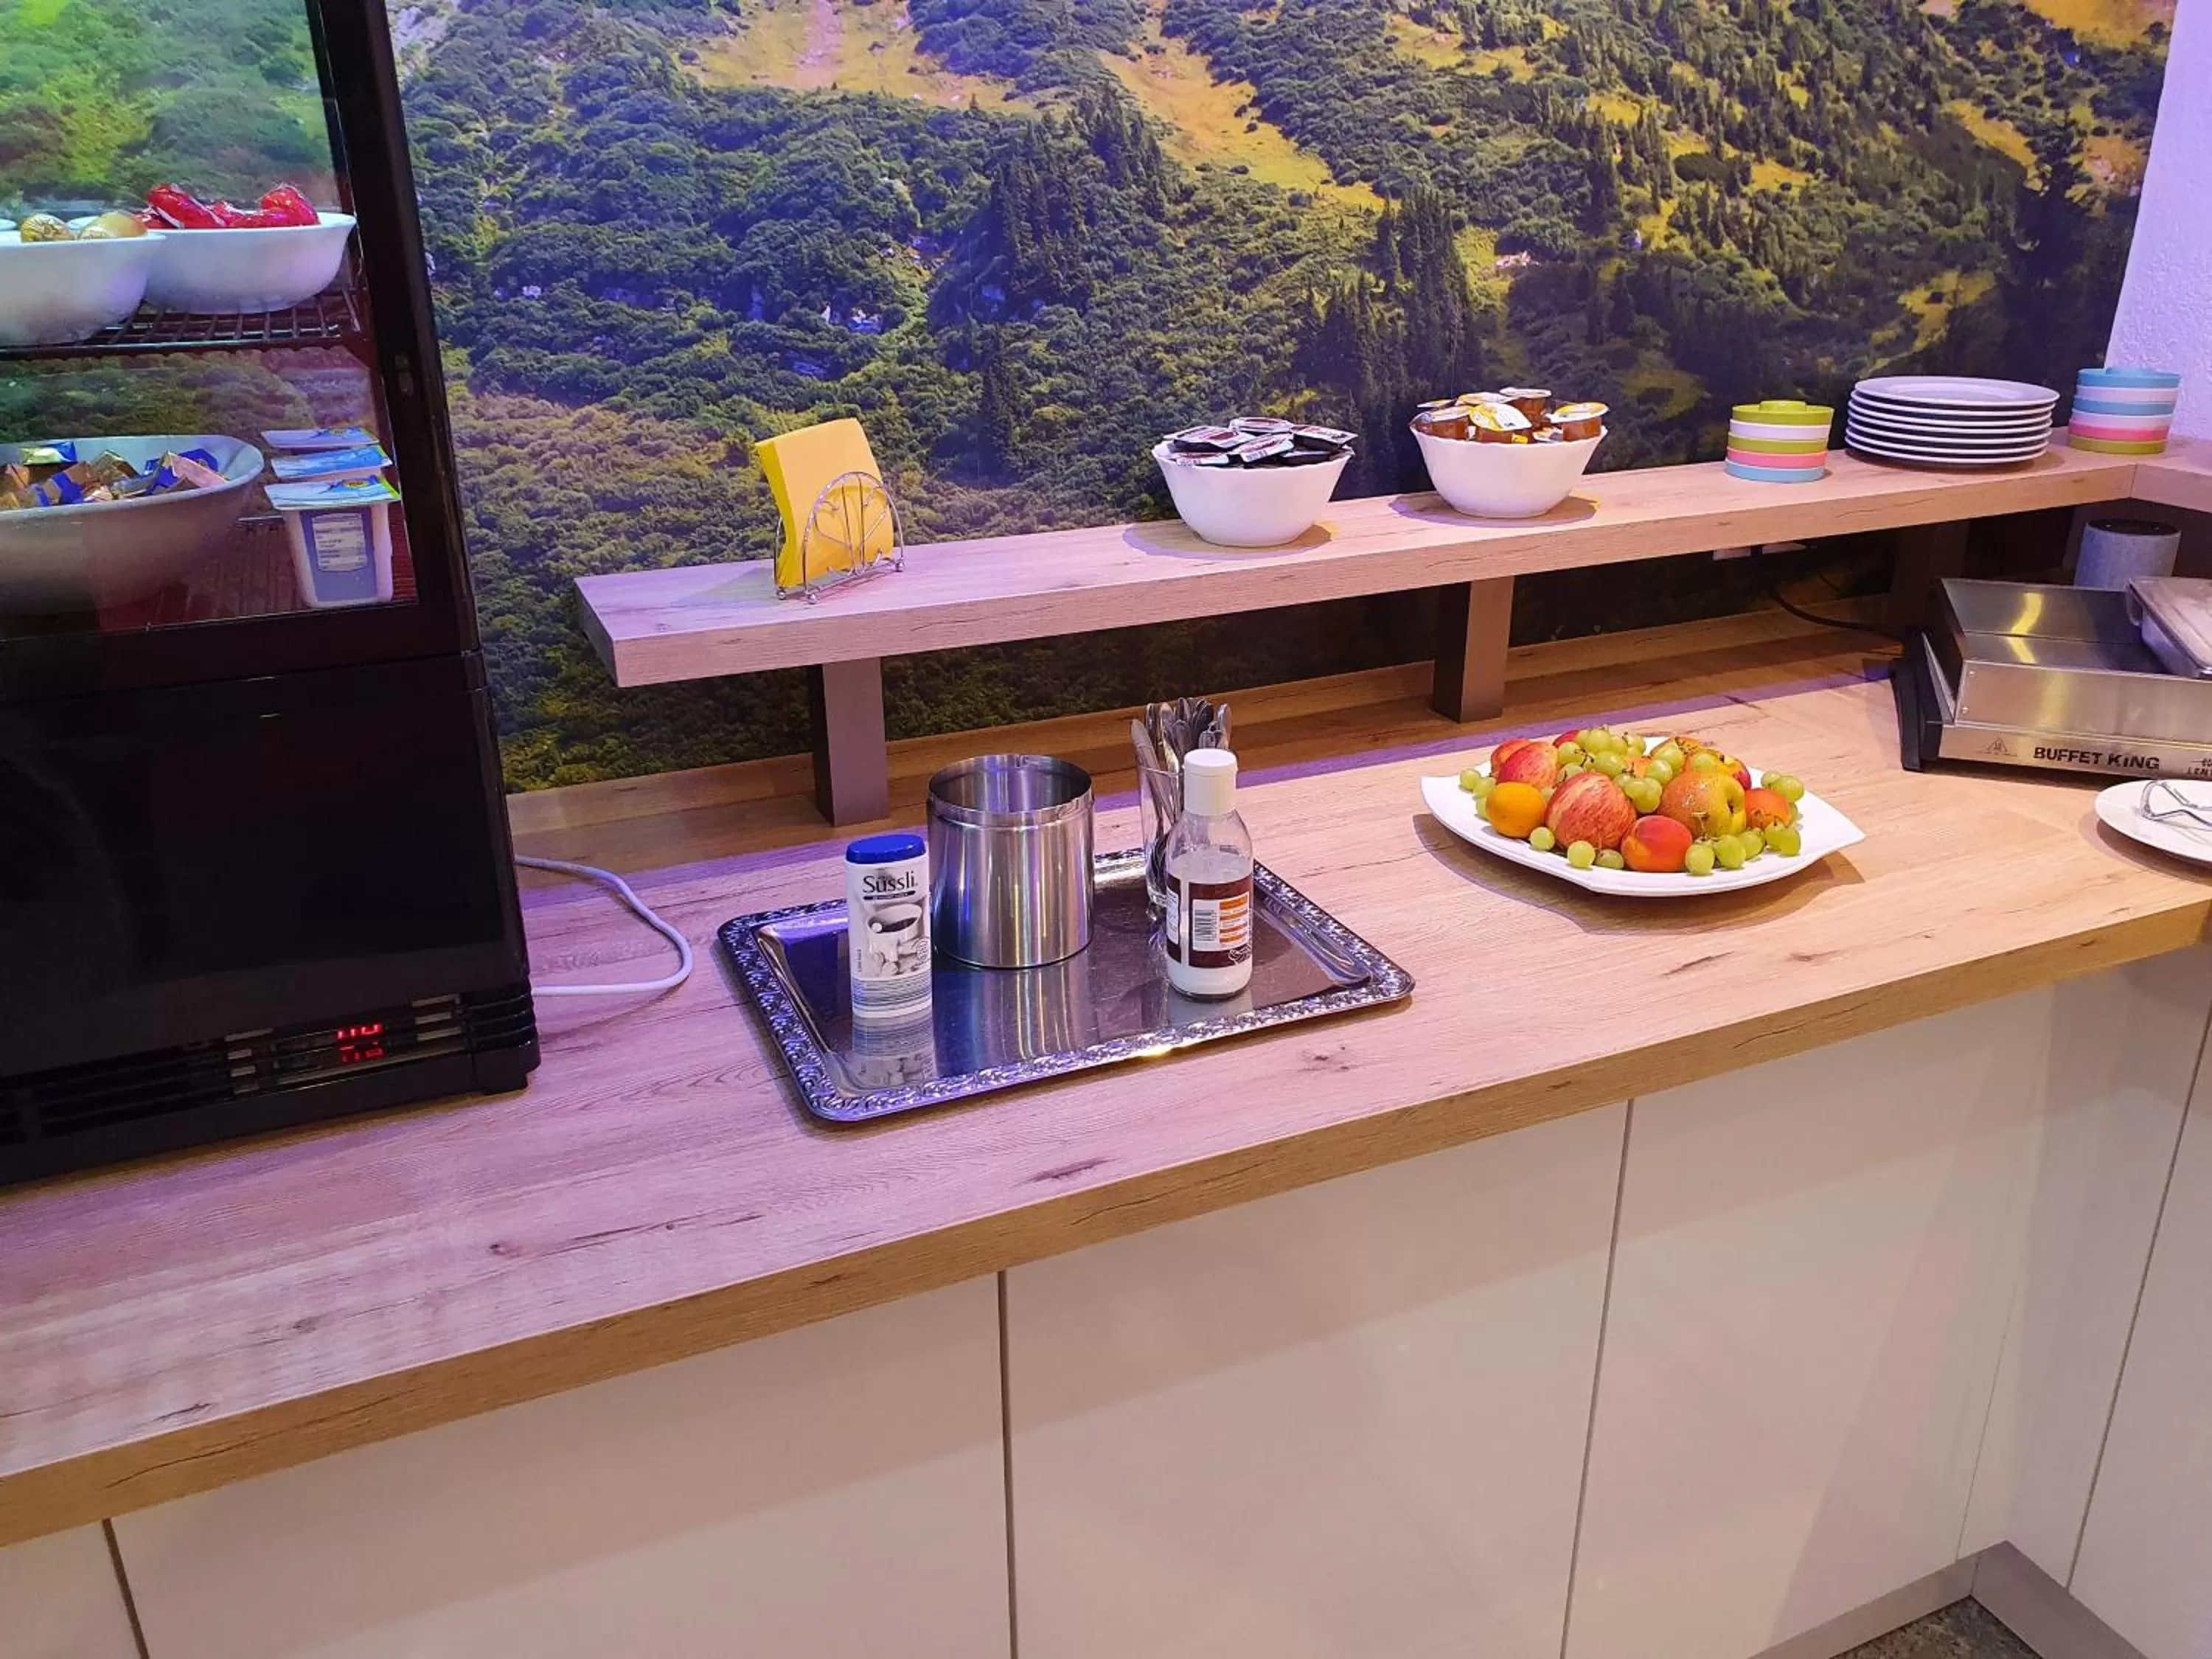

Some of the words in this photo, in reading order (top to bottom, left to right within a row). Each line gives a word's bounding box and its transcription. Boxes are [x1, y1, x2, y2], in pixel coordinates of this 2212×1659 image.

[2034, 747, 2103, 765] BUFFET
[2107, 754, 2160, 770] KING
[863, 870, 915, 893] Süssli
